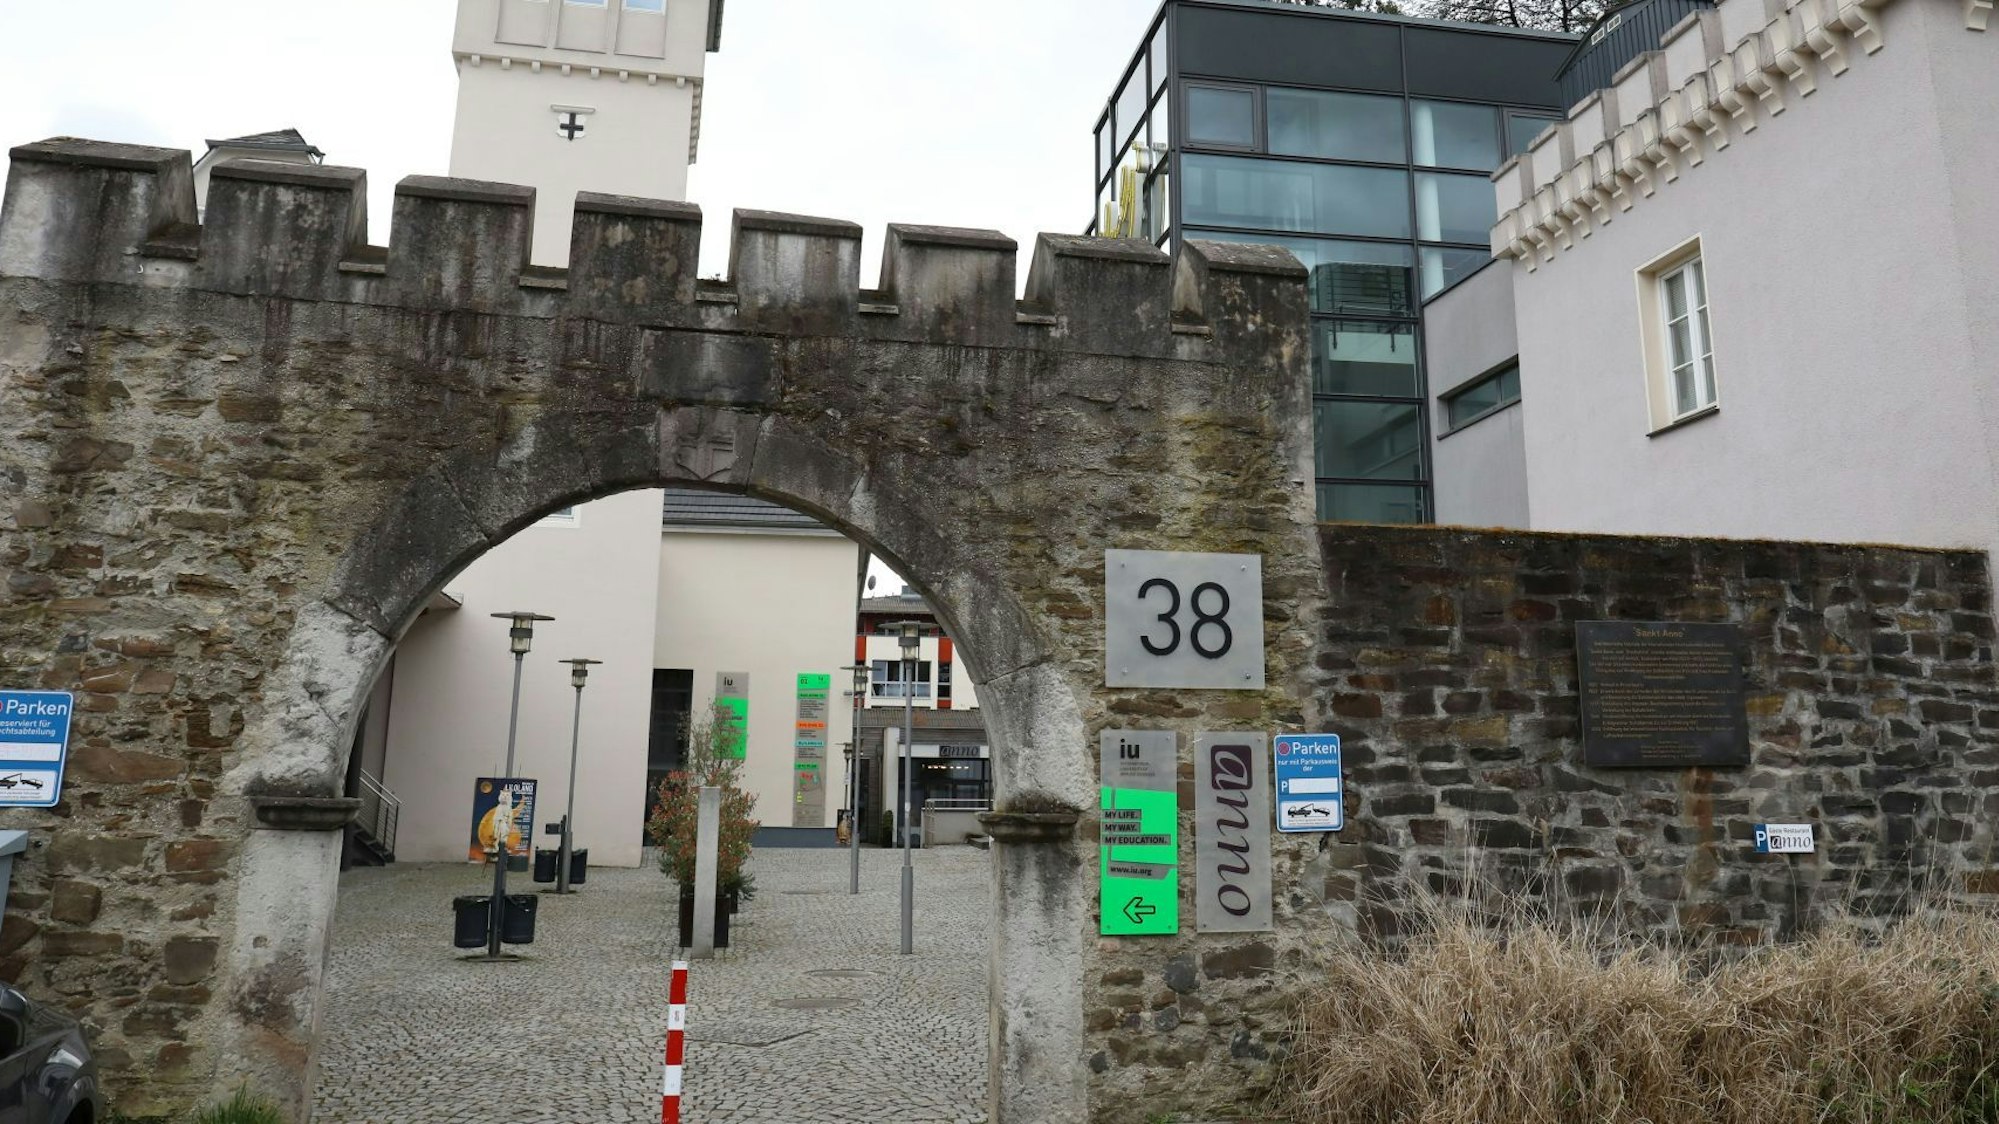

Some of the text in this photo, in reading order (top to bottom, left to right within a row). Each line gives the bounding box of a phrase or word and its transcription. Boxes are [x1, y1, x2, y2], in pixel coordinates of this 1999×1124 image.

[1138, 578, 1232, 659] 38
[5, 699, 68, 716] Parken
[0, 719, 52, 728] eserviert für
[0, 727, 56, 737] chtsabteilung
[940, 746, 979, 757] anno
[1120, 738, 1140, 759] iu
[1292, 741, 1337, 755] Parken
[1104, 811, 1138, 819] MY LIFE.
[1213, 748, 1252, 917] anno
[1118, 837, 1168, 845] EDUCATION.
[1771, 836, 1811, 849] anno
[1110, 866, 1152, 876] www.iu.org
